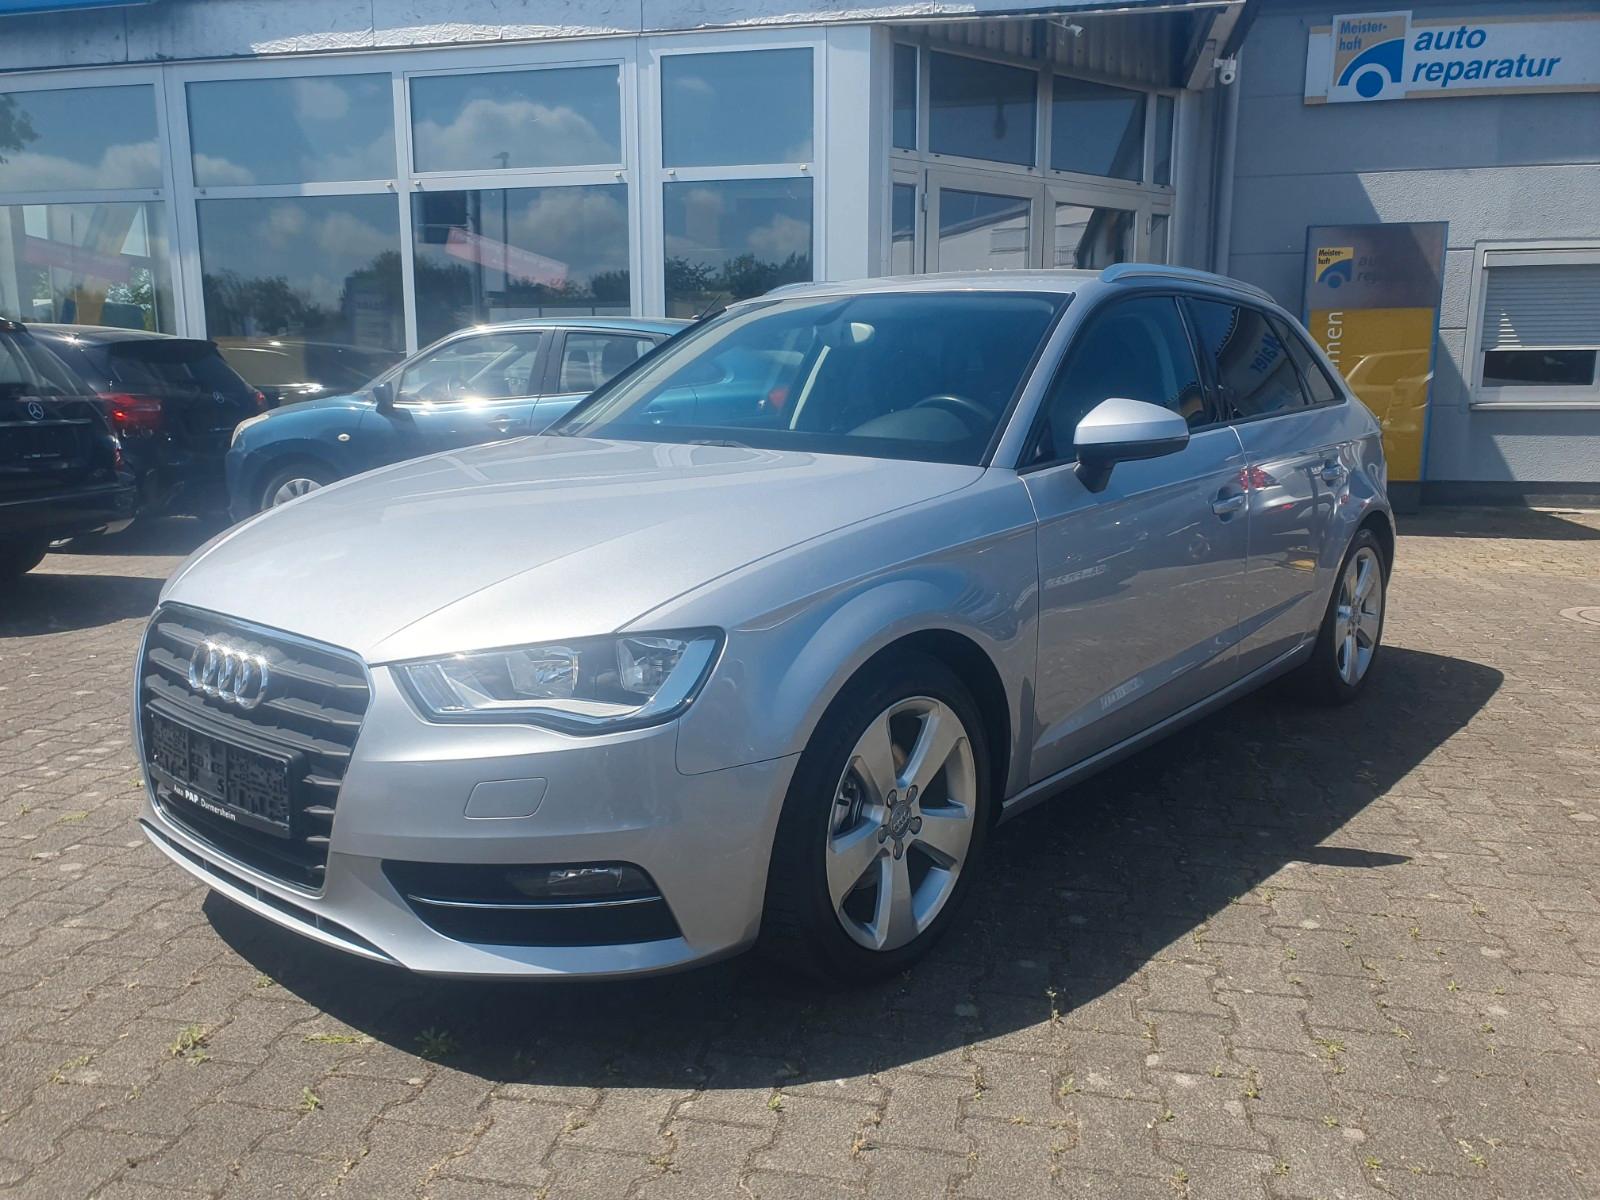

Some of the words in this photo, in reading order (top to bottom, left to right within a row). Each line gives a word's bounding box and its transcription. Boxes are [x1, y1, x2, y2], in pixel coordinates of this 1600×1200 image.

[1340, 20, 1388, 34] Meister-
[1339, 36, 1362, 50] haft
[1414, 25, 1486, 51] auto
[1412, 53, 1561, 87] reparatur
[1326, 311, 1345, 370] men
[185, 790, 199, 804] PAP
